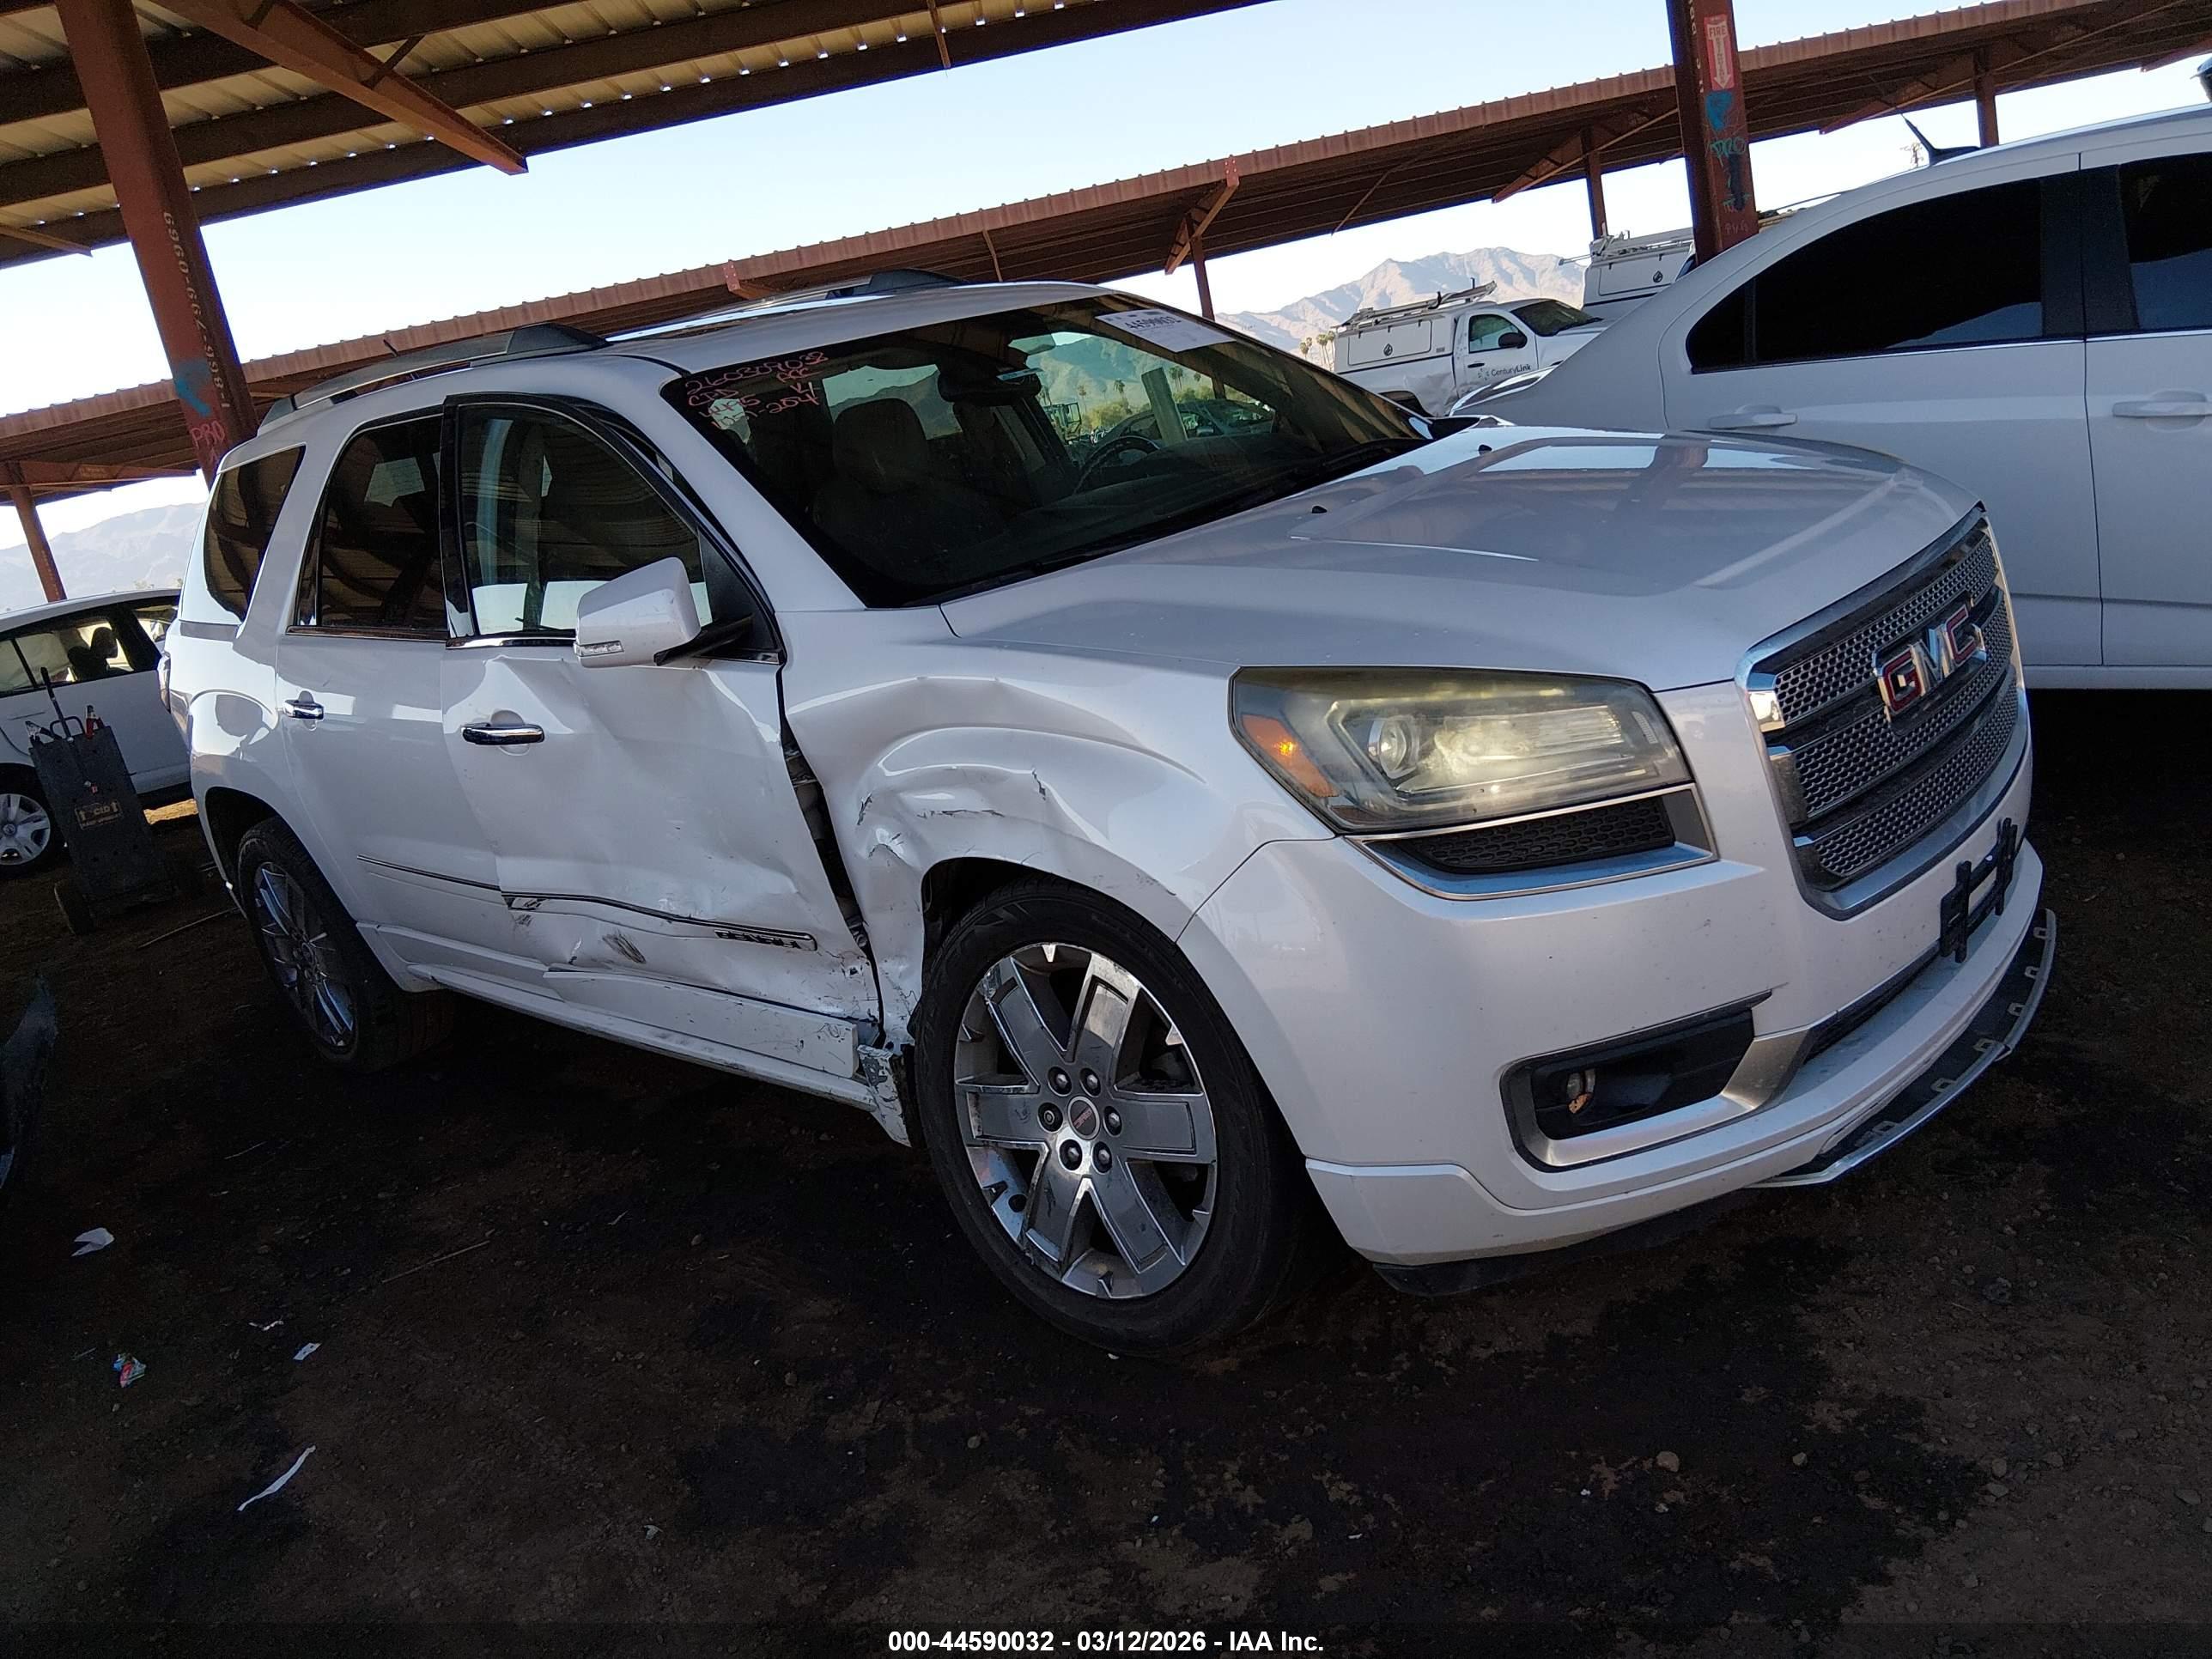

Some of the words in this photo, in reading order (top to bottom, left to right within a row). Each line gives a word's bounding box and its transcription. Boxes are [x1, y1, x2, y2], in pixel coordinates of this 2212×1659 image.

[1709, 25, 1727, 37] FIRE
[162, 211, 231, 409] 1-866-799-0969
[1491, 363, 1531, 377] CenturyLink
[1874, 605, 1986, 718] GMC
